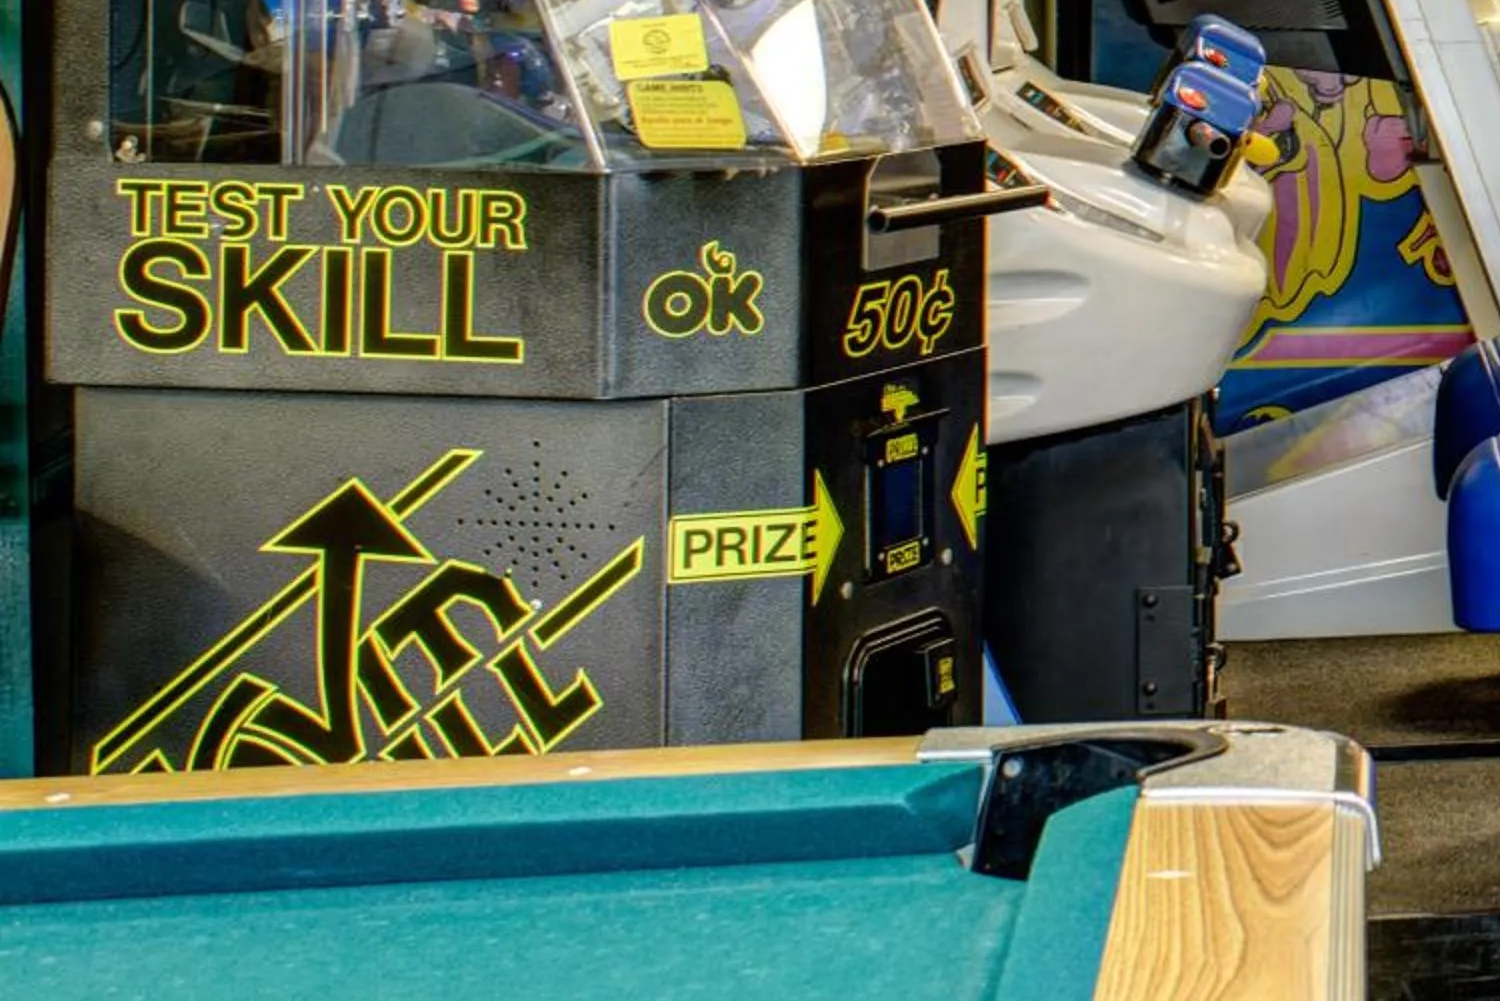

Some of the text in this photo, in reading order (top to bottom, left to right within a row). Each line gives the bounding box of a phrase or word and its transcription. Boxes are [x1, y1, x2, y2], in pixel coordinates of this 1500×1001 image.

[116, 179, 528, 250] TEST YOUR
[114, 237, 525, 364] SKILL
[843, 269, 955, 358] 50¢
[681, 518, 818, 570] PRIZE
